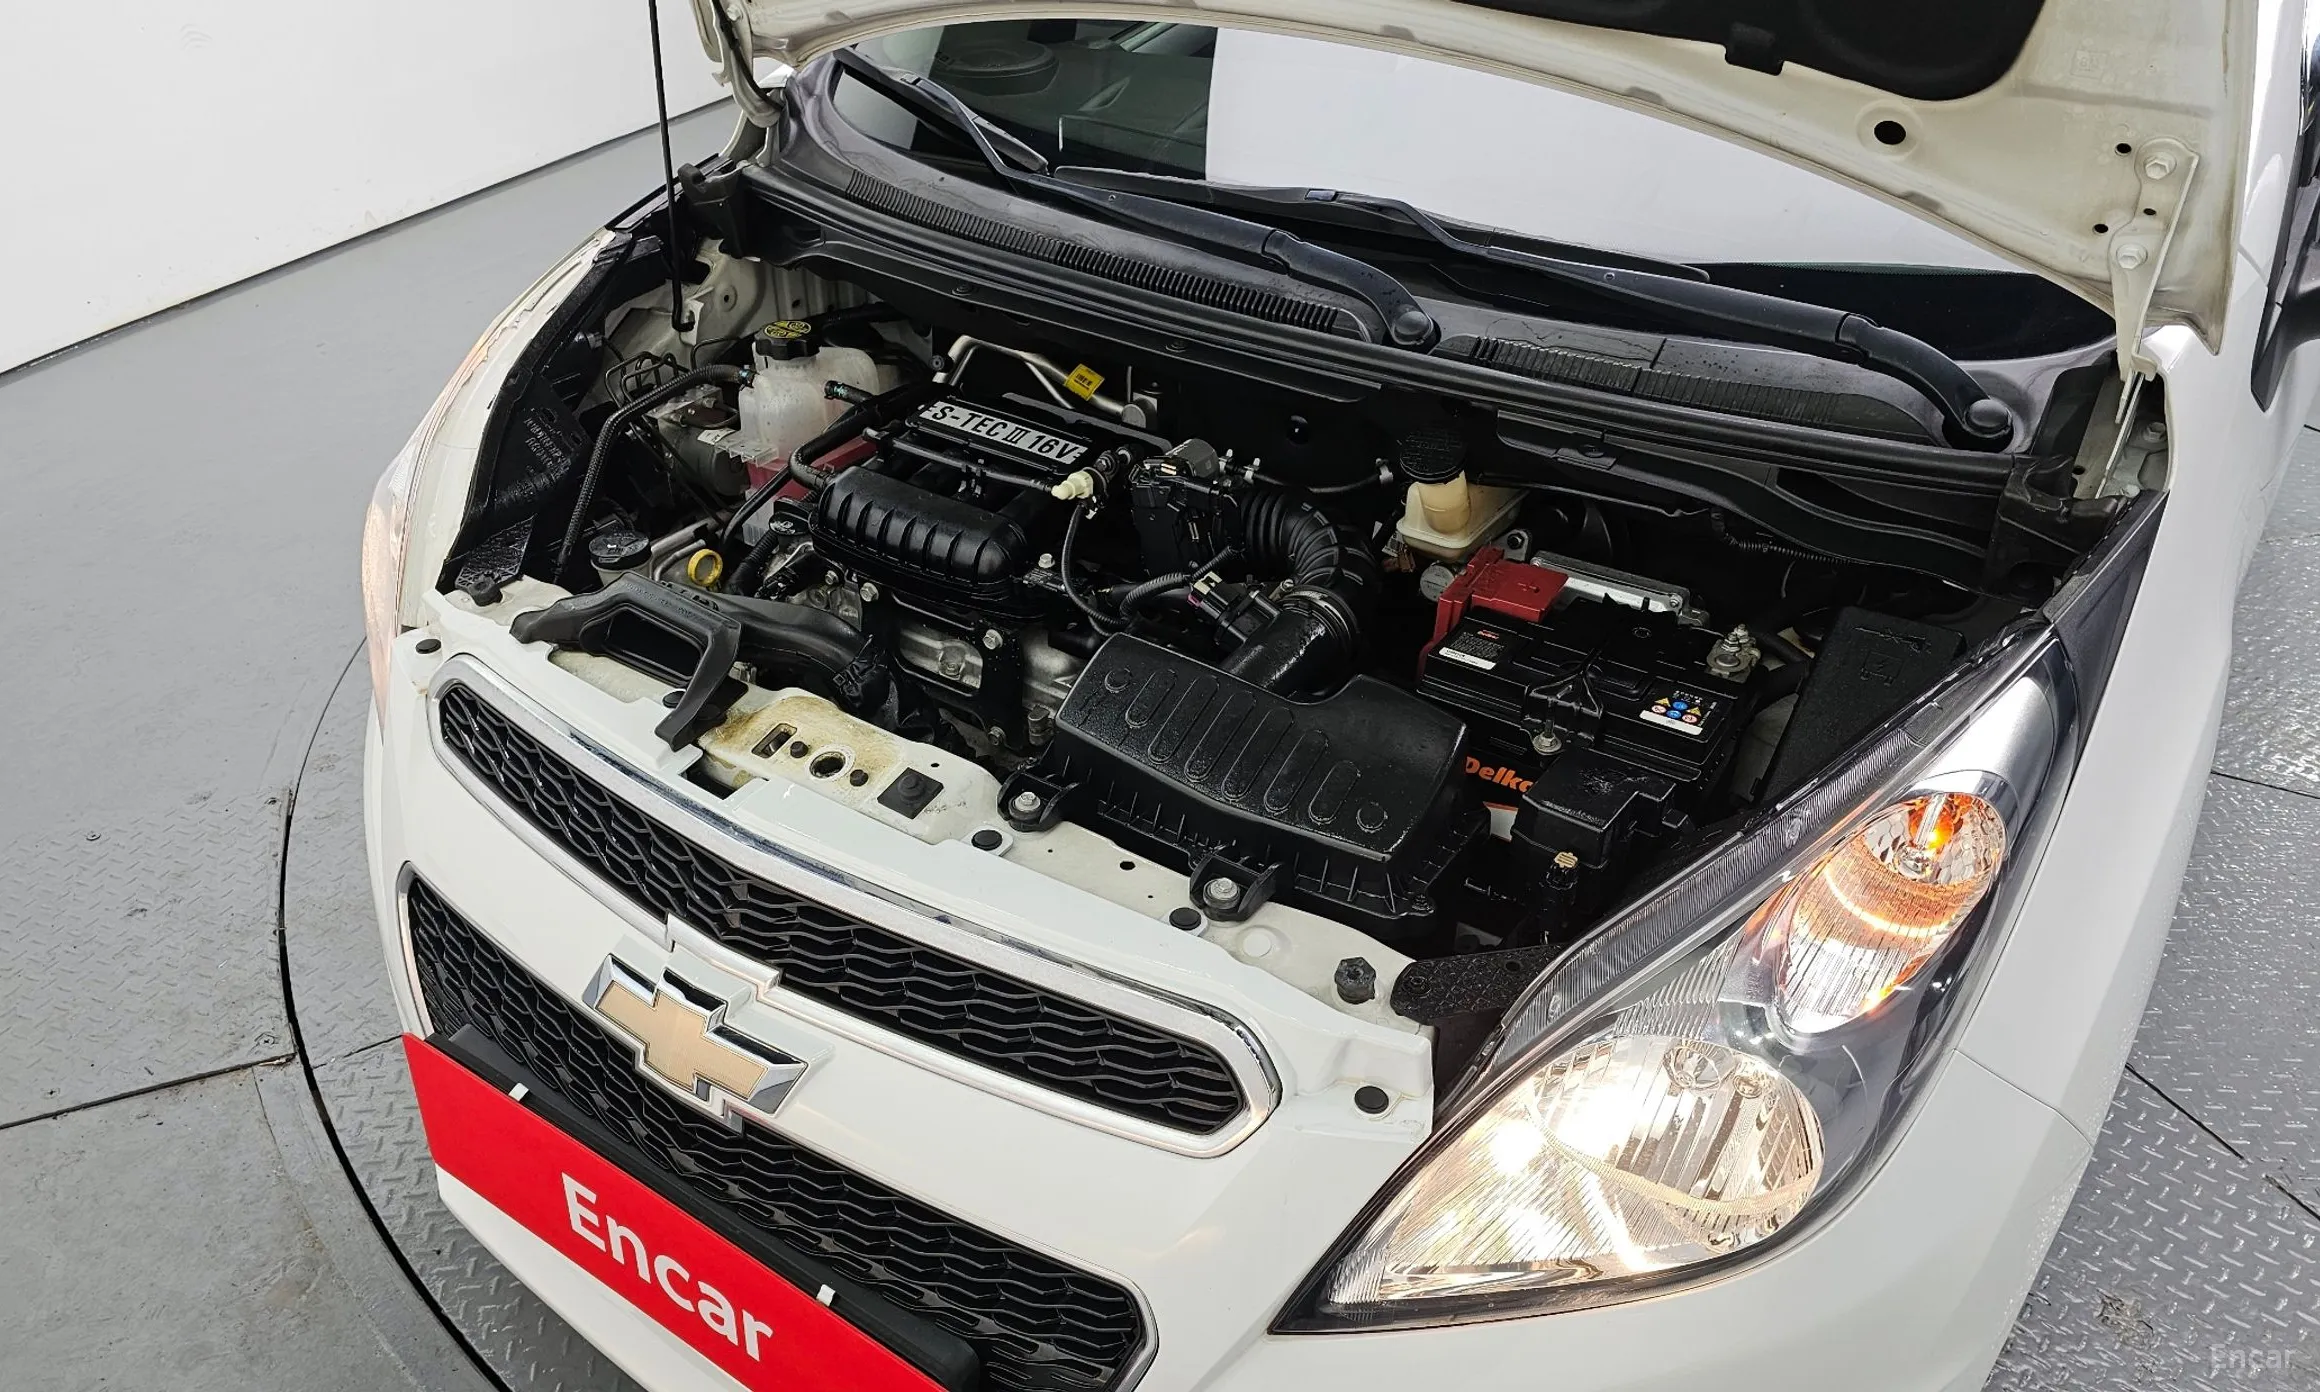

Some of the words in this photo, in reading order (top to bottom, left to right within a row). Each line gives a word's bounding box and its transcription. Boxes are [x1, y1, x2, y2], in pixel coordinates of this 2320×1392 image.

[931, 405, 1008, 437] S-TEC
[1027, 435, 1079, 460] 16V
[561, 1171, 773, 1362] Encar
